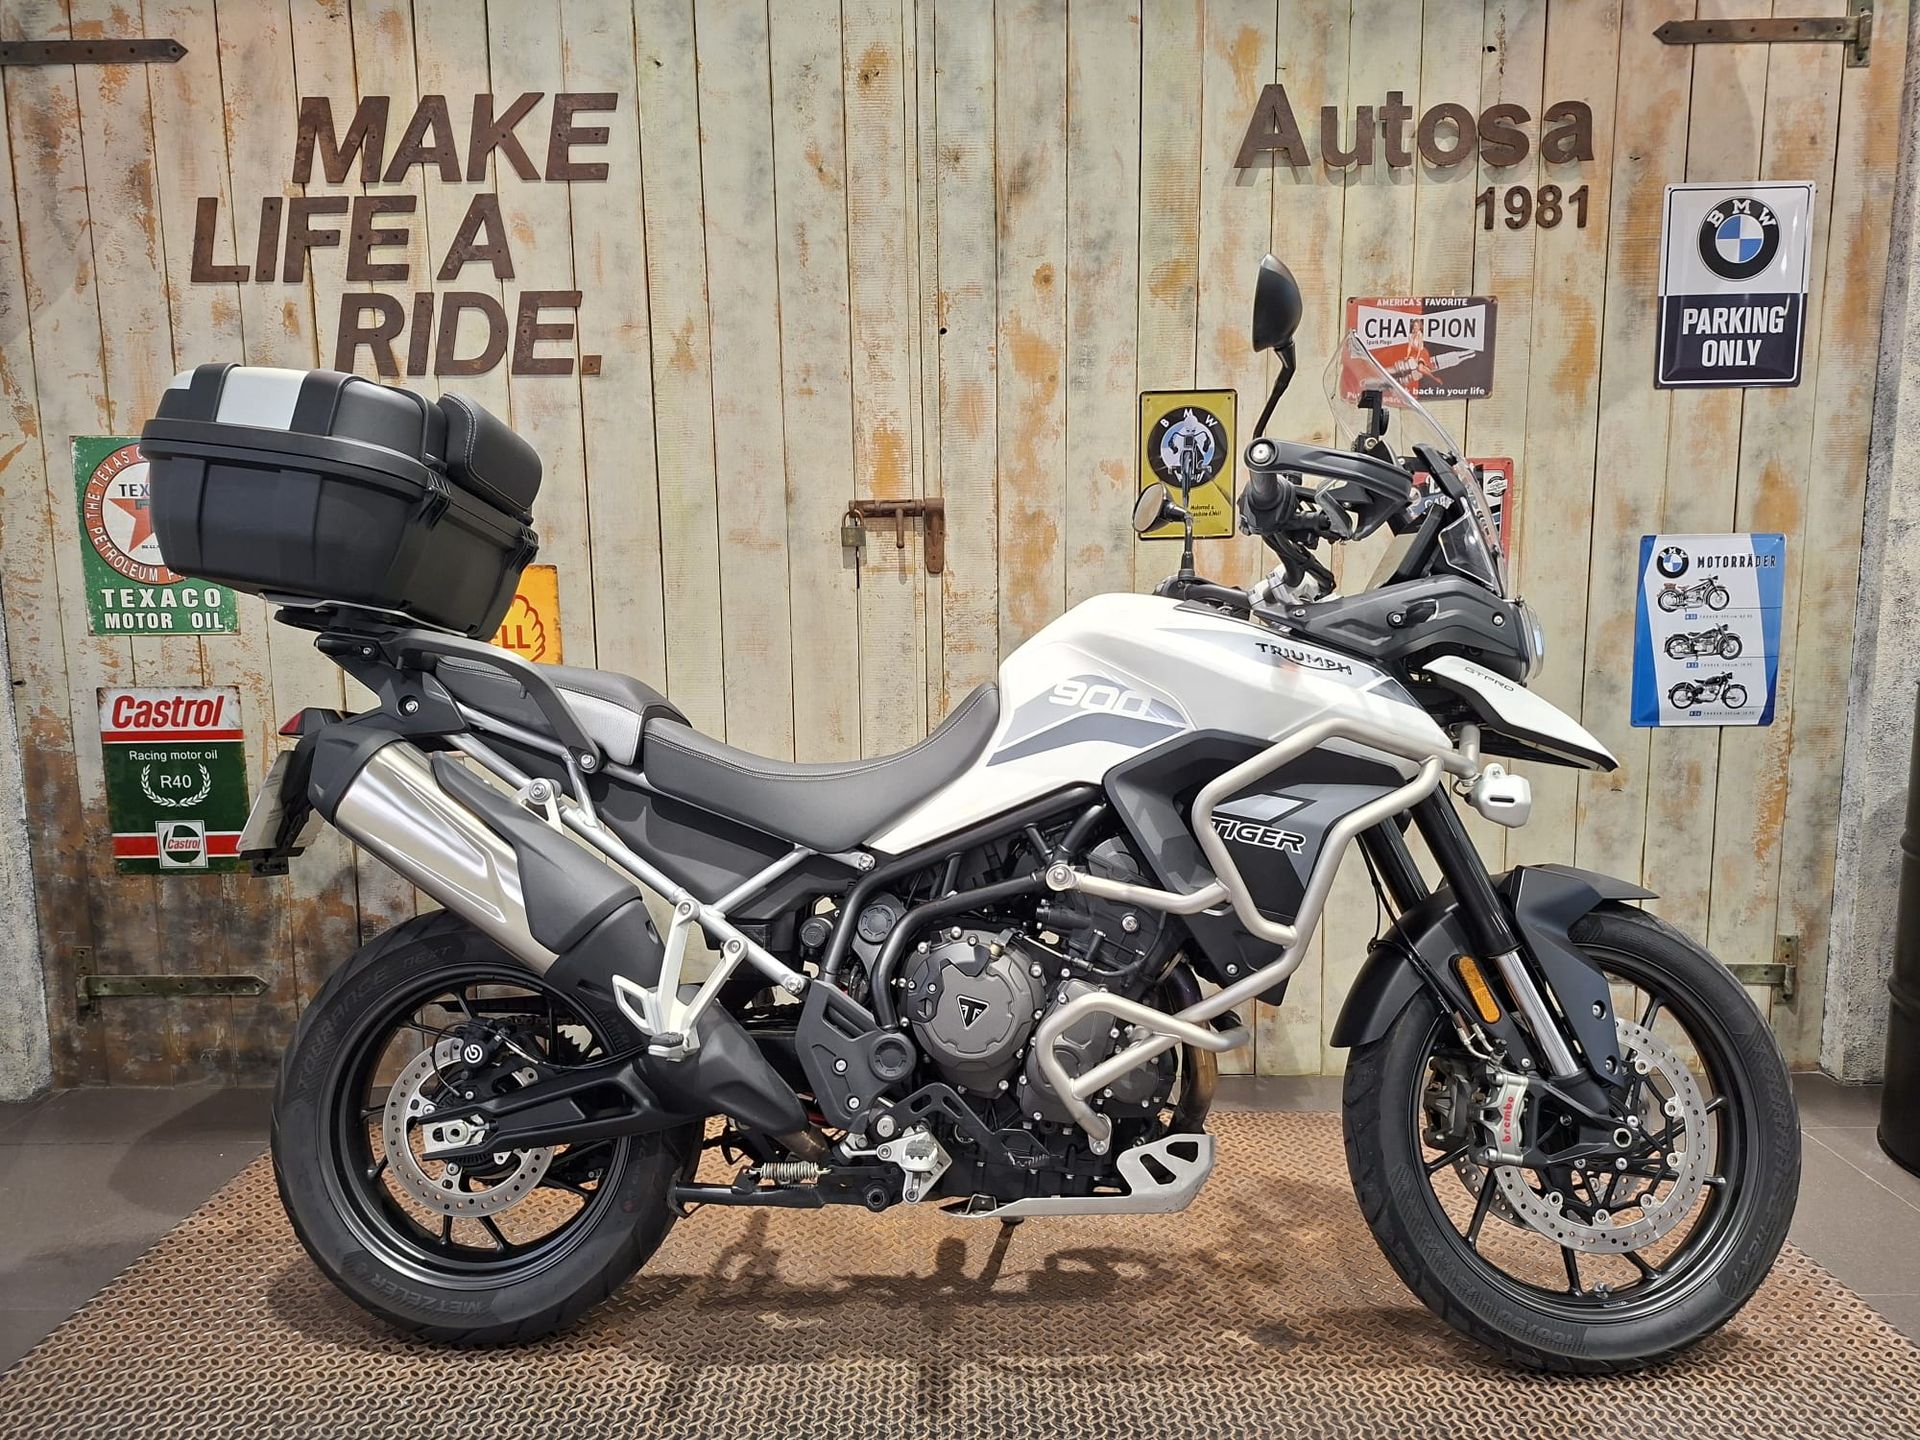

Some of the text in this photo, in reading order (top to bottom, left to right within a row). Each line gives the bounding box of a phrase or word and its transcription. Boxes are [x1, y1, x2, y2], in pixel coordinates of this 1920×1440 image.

[292, 92, 618, 183] MAKE
[1233, 83, 1594, 168] Autosa
[1475, 185, 1590, 230] 1981
[1706, 199, 1777, 228] BMW
[190, 193, 515, 283] LIFE A
[1376, 297, 1468, 307] AMERICA'S FAVORITE
[333, 291, 603, 376] RIDE.
[1682, 306, 1785, 335] PARKING
[1701, 339, 1763, 367] ONLY
[1412, 387, 1434, 396] back
[1436, 387, 1444, 395] in
[1446, 388, 1468, 397] your
[1470, 387, 1485, 395] life
[86, 450, 130, 518] THE TEXAS
[118, 483, 150, 497] TEX
[90, 527, 159, 582] PETROLEUM
[1697, 553, 1776, 568] MOTORRÄDER
[101, 587, 222, 608] TEXACO
[104, 612, 224, 629] MOTOR OIL
[1255, 642, 1353, 675] TRIUMPH
[111, 695, 225, 729] Castrol
[1048, 679, 1151, 716] 900
[129, 749, 218, 762] Racing motor oil
[160, 774, 192, 789] R40
[167, 838, 200, 850] Castrol
[1211, 816, 1306, 854] TIGER
[1502, 1096, 1514, 1142] brembo
